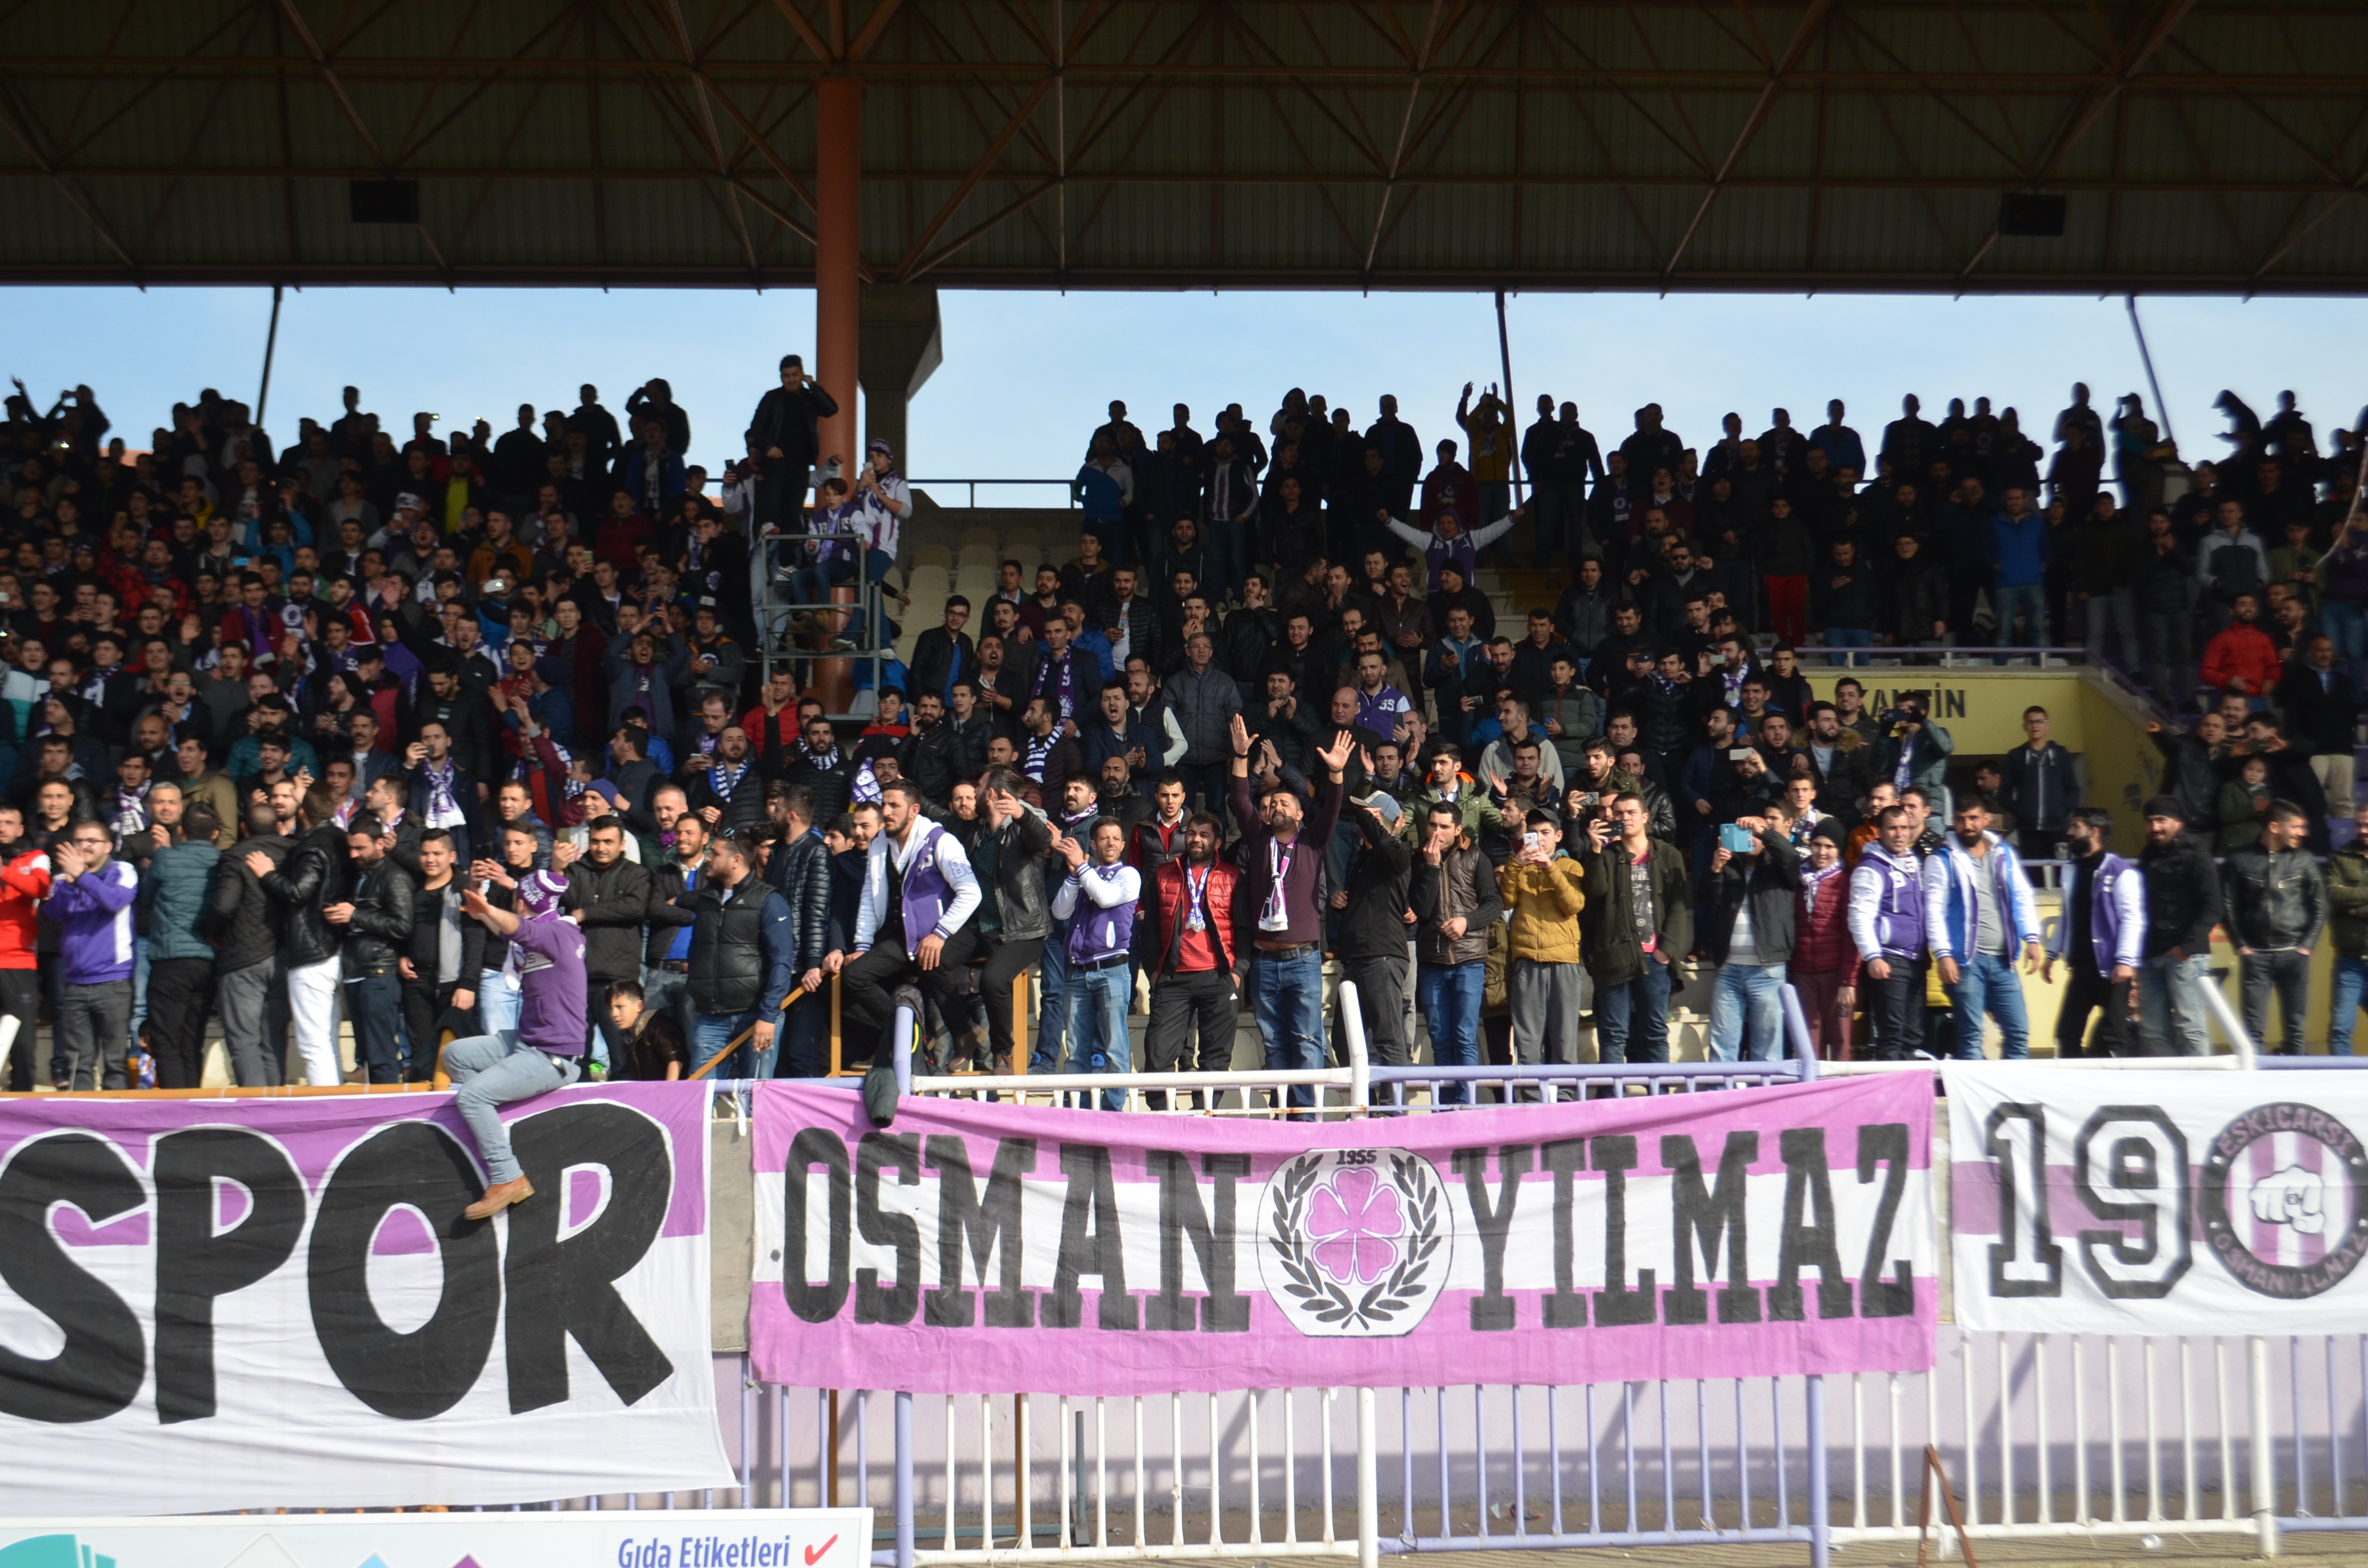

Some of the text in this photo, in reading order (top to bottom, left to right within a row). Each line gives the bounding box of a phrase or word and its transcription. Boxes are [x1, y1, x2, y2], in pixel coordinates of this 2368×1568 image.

[1336, 1150, 1377, 1164] 1955
[0, 1100, 674, 1423] SPOR
[783, 1123, 1914, 1332] OSMAN YILMAZ
[618, 1535, 790, 1568] Gıda Etiketleri
